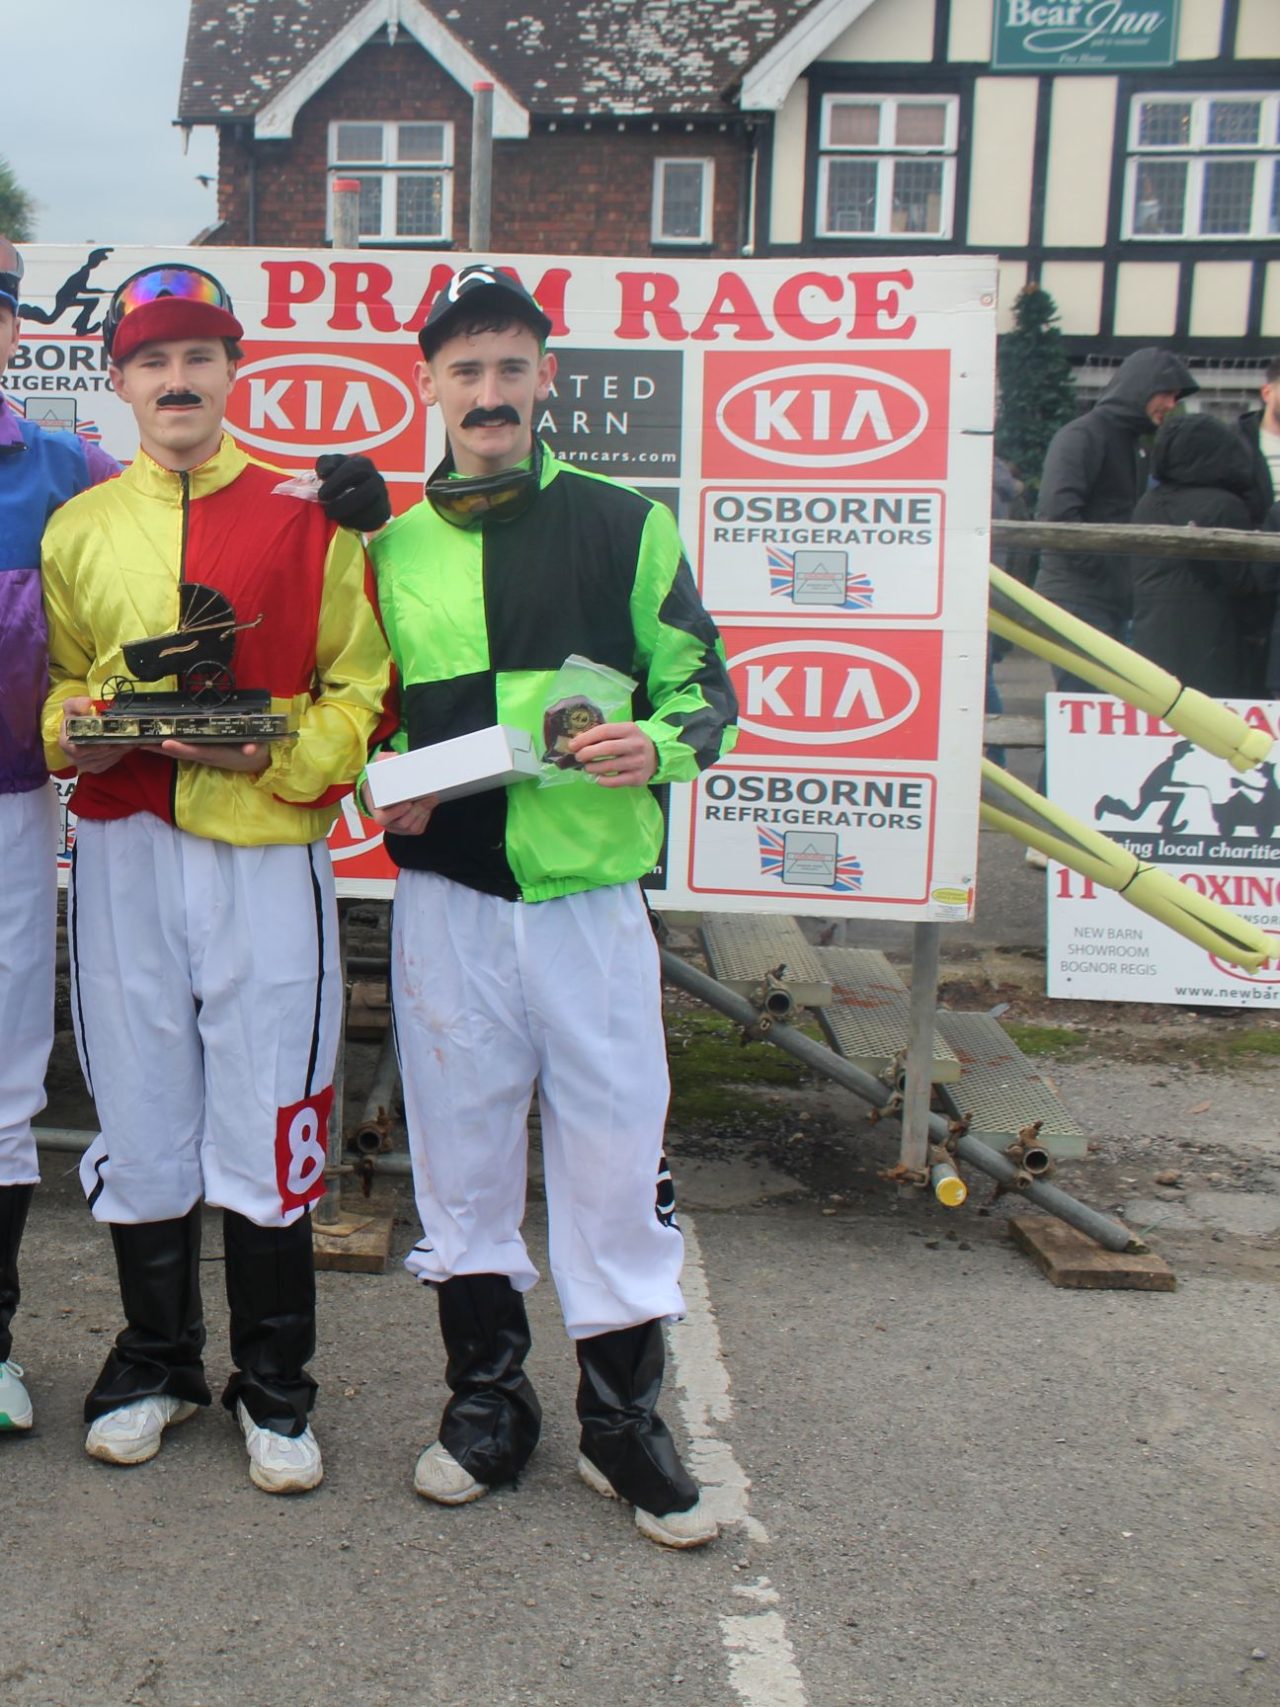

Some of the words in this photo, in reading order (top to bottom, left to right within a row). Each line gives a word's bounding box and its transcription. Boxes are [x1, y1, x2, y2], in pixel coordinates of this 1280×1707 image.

[1006, 0, 1083, 27] Bear
[614, 268, 917, 341] RACE
[248, 379, 381, 432] KIA
[753, 390, 894, 441] KIA
[552, 451, 677, 462] arncars.com
[713, 497, 932, 524] OSBORNE
[713, 528, 932, 545] REFRIGERATORS
[746, 666, 884, 719] KIA
[705, 775, 922, 809] OSBORNE
[705, 806, 922, 830] REFRIGERATORS
[1157, 839, 1205, 857] local
[1209, 841, 1280, 860] charitie
[1074, 927, 1104, 939] NEW
[1107, 928, 1143, 940] BARN
[1067, 944, 1149, 958] SHOWROOM
[1060, 961, 1117, 974] BOGNOR
[1120, 963, 1157, 976] REGIS
[1175, 986, 1280, 1000] www.newbar
[288, 1106, 326, 1194] 8
